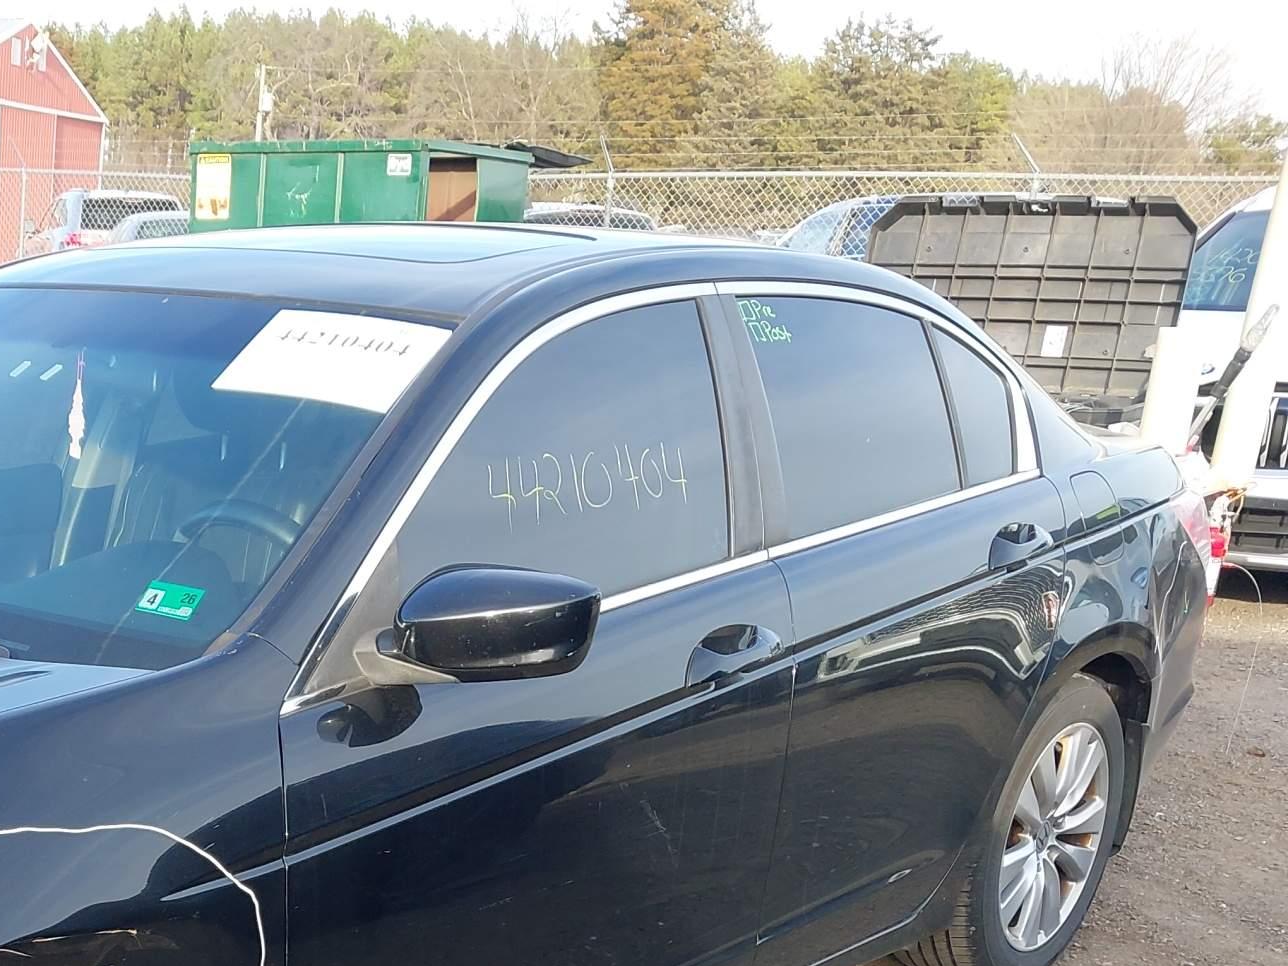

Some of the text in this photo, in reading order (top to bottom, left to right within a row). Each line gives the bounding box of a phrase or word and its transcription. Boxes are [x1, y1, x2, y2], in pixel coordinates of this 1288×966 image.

[750, 299, 776, 319] Pre
[760, 320, 792, 343] Post
[487, 441, 688, 534] 44210404
[146, 592, 198, 606] 4 26
